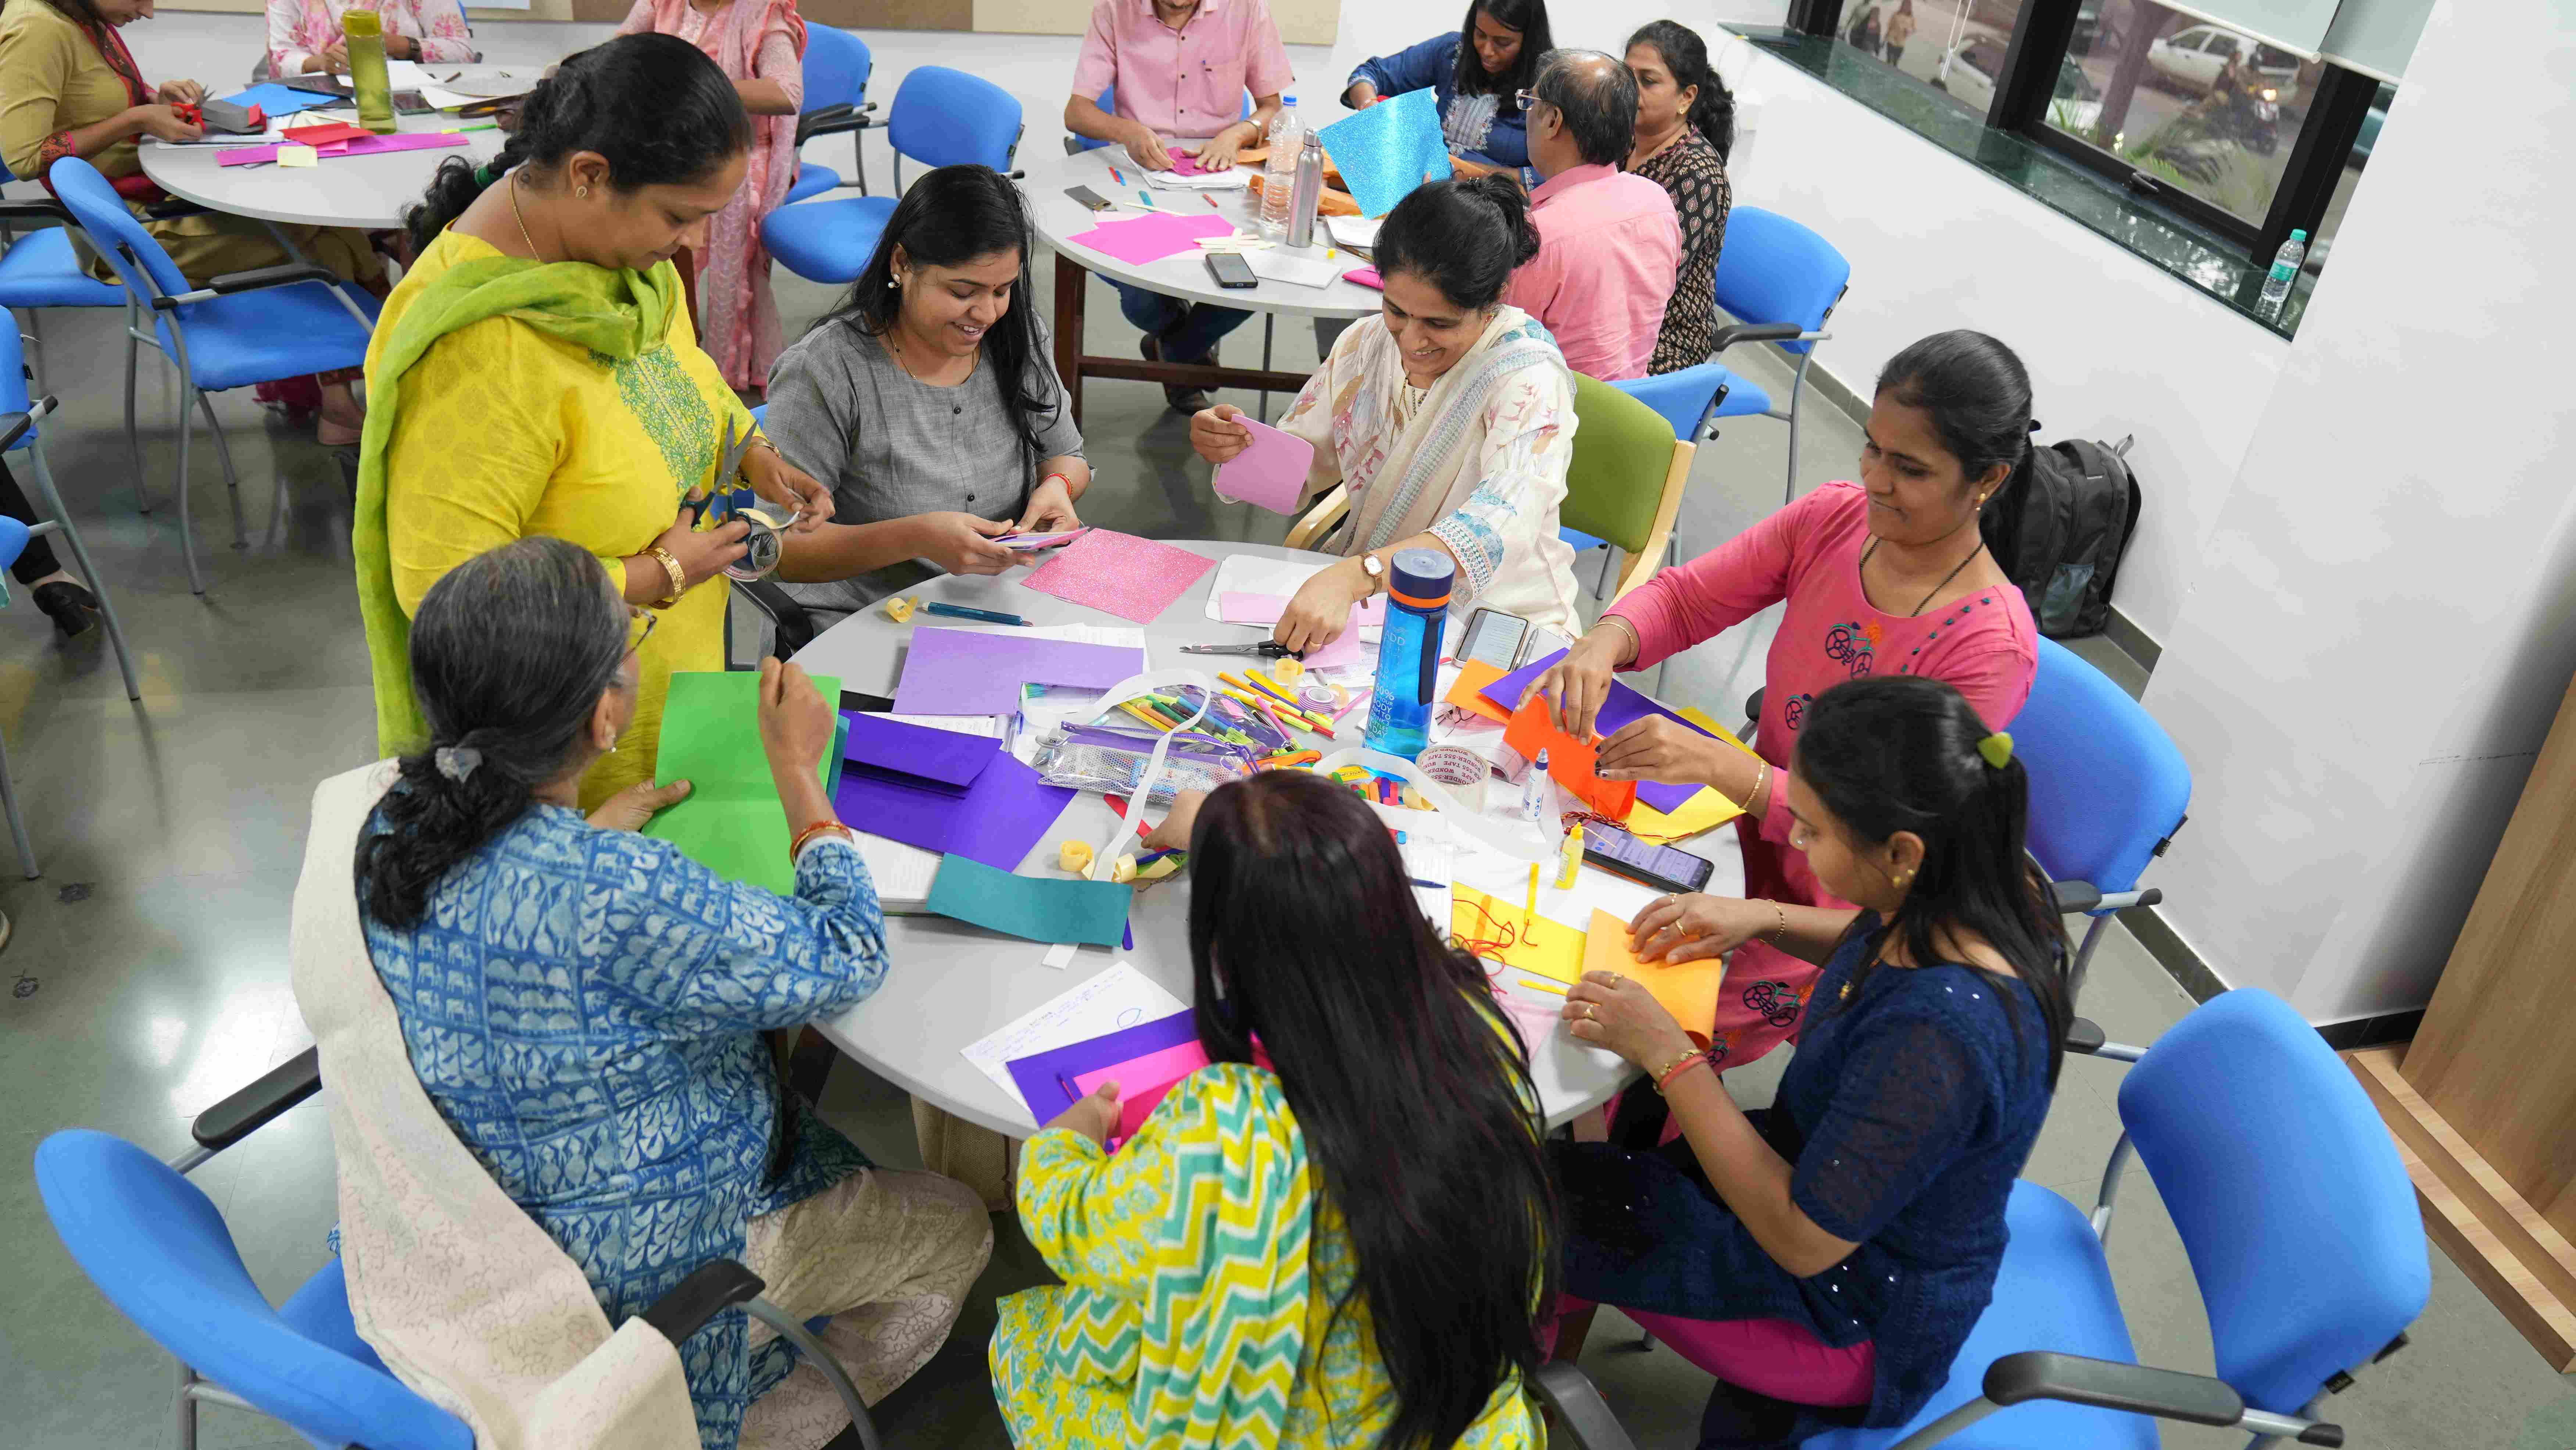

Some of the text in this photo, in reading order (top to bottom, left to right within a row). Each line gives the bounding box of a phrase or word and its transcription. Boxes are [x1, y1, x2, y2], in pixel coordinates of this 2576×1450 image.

[1376, 682, 1395, 701] 60%
[1373, 696, 1392, 713] BODY
[1381, 711, 1391, 720] TO
[1461, 772, 1475, 783] TAPE
